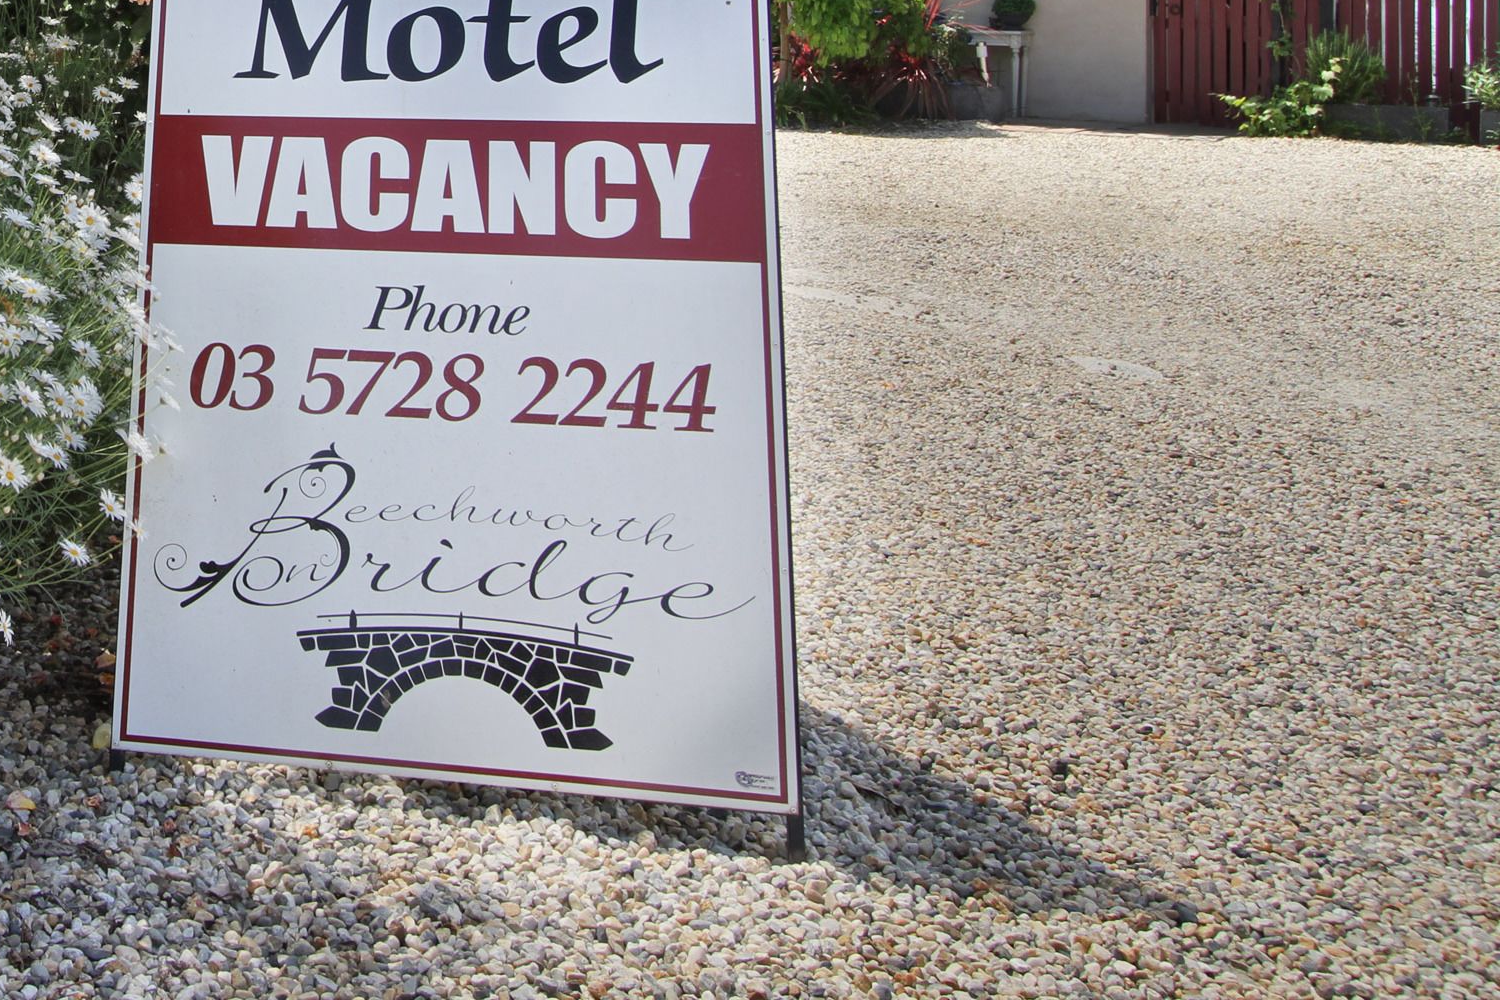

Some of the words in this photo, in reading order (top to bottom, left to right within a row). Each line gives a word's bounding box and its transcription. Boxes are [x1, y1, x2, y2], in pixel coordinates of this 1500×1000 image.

[200, 134, 710, 240] VACANCY
[363, 285, 531, 336] Phone
[189, 342, 276, 412] 03
[299, 347, 486, 422] 5728
[510, 356, 717, 433] 2244
[235, 441, 694, 606] Beechworth
